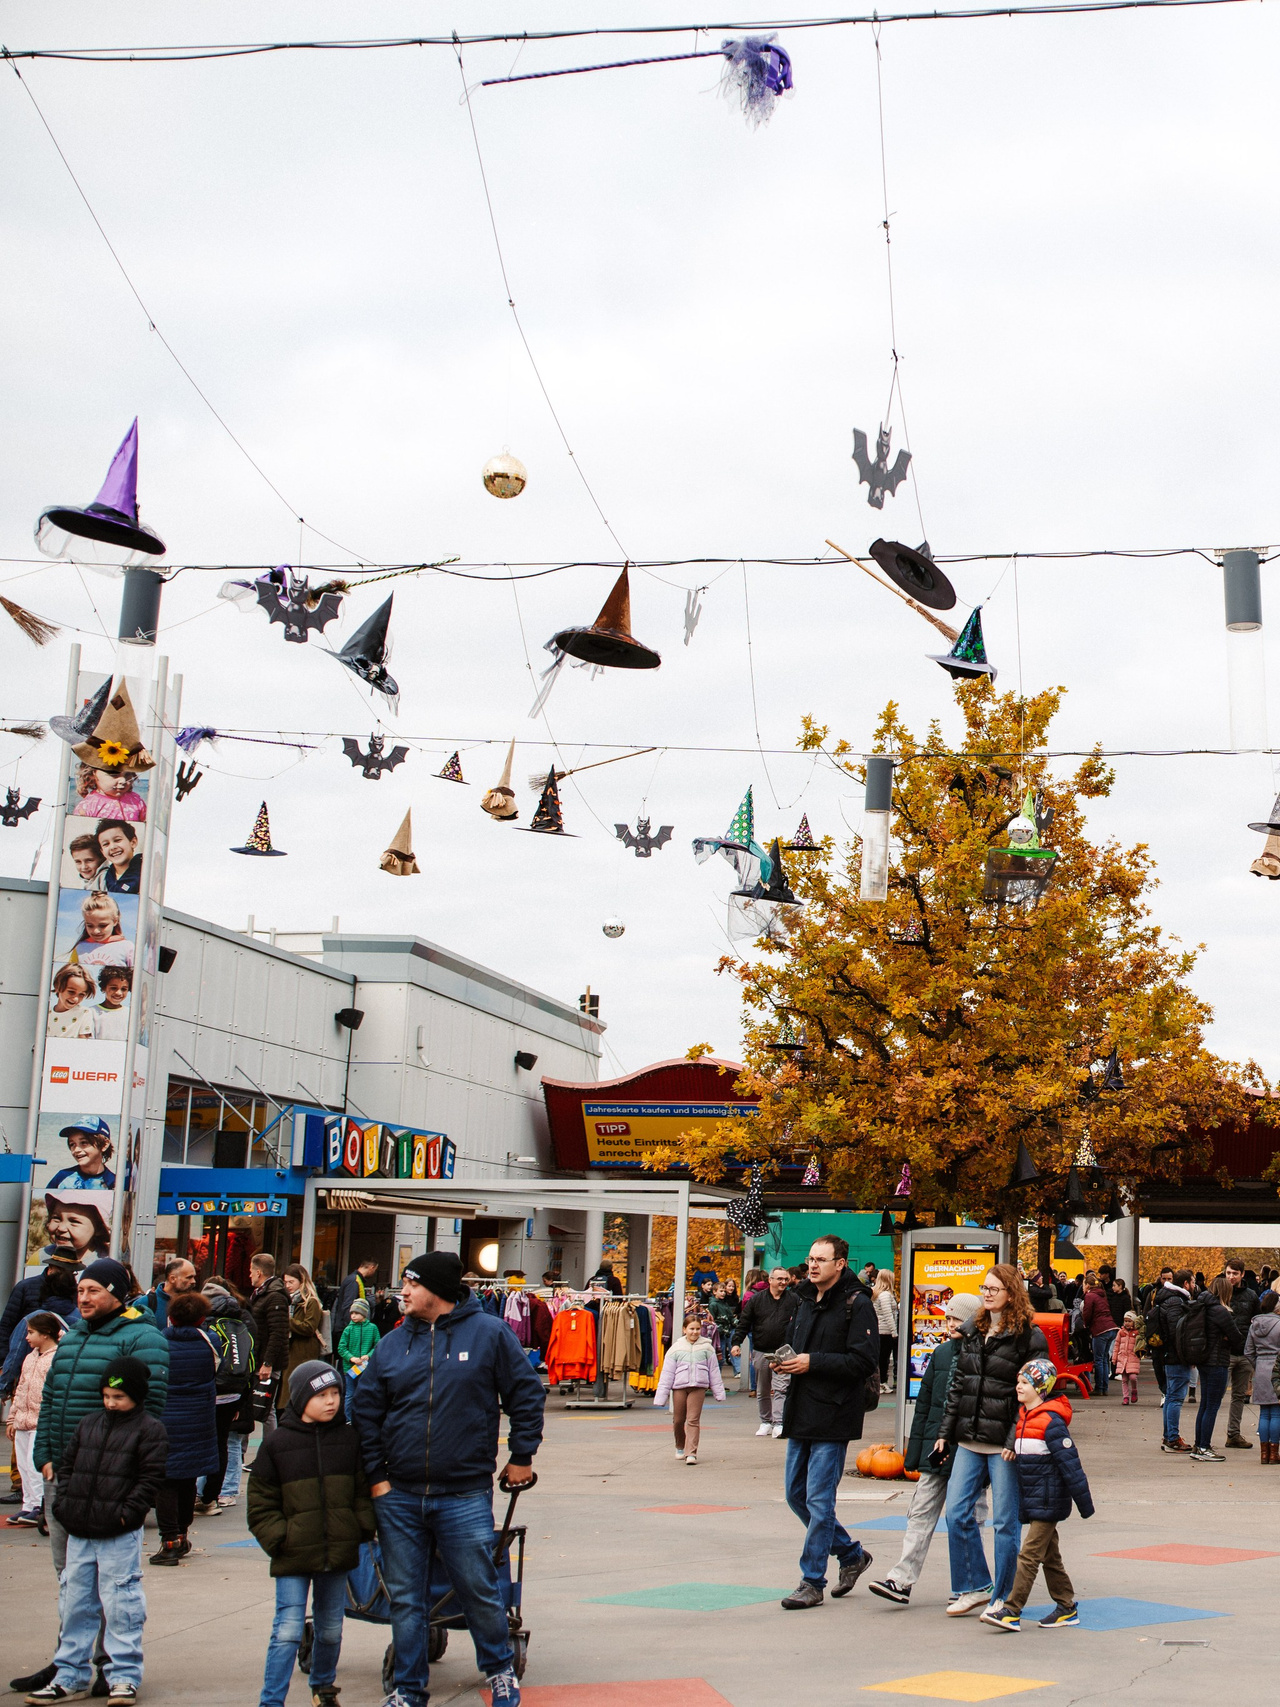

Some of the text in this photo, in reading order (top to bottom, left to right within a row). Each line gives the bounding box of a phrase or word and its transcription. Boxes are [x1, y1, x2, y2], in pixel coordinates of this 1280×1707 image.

[72, 1071, 118, 1082] WEAR
[587, 1106, 639, 1114] Jahreskarte
[692, 1107, 727, 1116] beliebig
[598, 1124, 627, 1134] TIPP
[597, 1138, 631, 1146] Heute
[329, 1126, 454, 1178] BOUTIQUE
[176, 1200, 281, 1213] BOUTIQUE
[924, 1264, 985, 1273] ÜBERNACHTUNG
